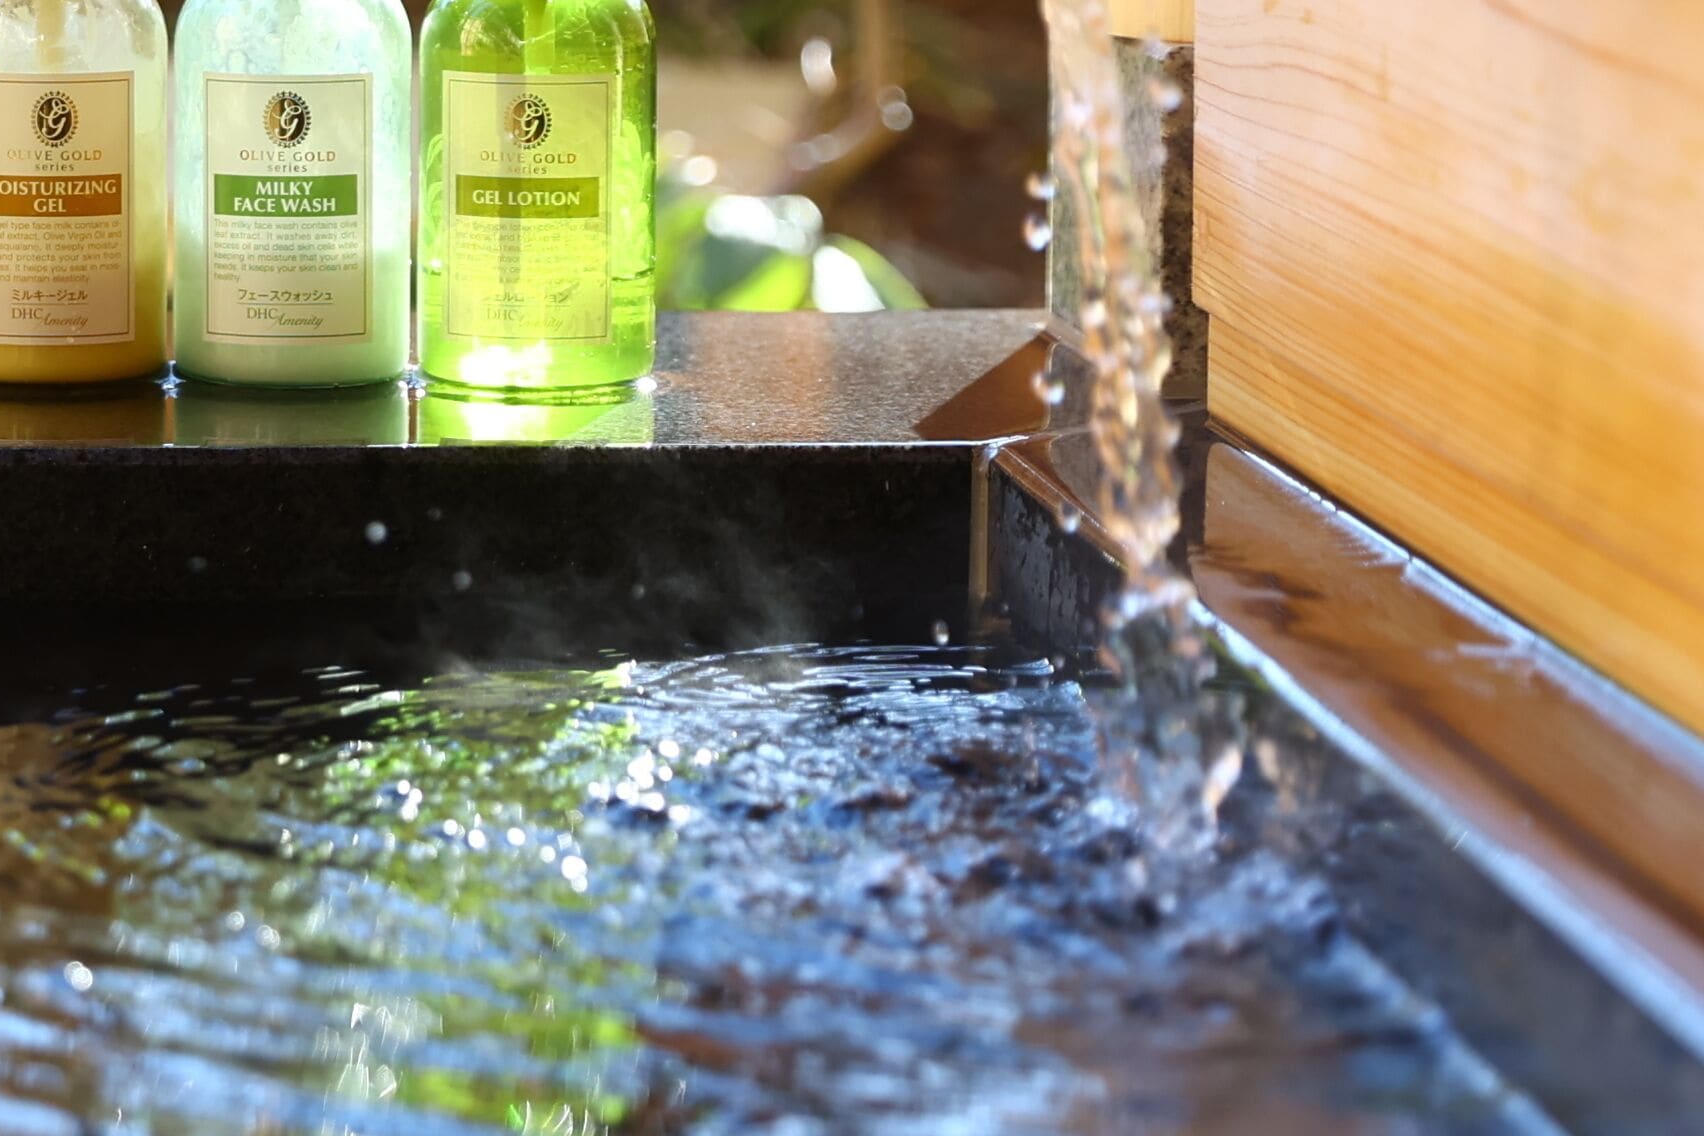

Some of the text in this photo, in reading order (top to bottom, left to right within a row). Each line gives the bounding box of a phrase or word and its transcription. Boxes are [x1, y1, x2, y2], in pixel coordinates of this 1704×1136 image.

[7, 149, 102, 161] OLIVE GOLD
[239, 149, 336, 162] OLIVE GOLD
[480, 151, 577, 164] OLIVE GOLD
[35, 164, 74, 172] series
[267, 164, 308, 173] series
[507, 165, 548, 174] series
[256, 181, 313, 195] MILKY
[472, 190, 581, 206] GEL LOTION
[33, 198, 66, 212] GEL
[234, 197, 336, 213] FACE WASH
[301, 220, 338, 230] contains
[68, 232, 93, 243] Virgin
[16, 253, 57, 262] protects
[257, 253, 297, 262] moisture
[276, 265, 297, 274] your
[12, 289, 89, 301] ミルキージェル
[238, 289, 334, 302] フェースウォッシュ
[11, 307, 89, 329] DHC Amenity
[246, 307, 278, 320] DHC
